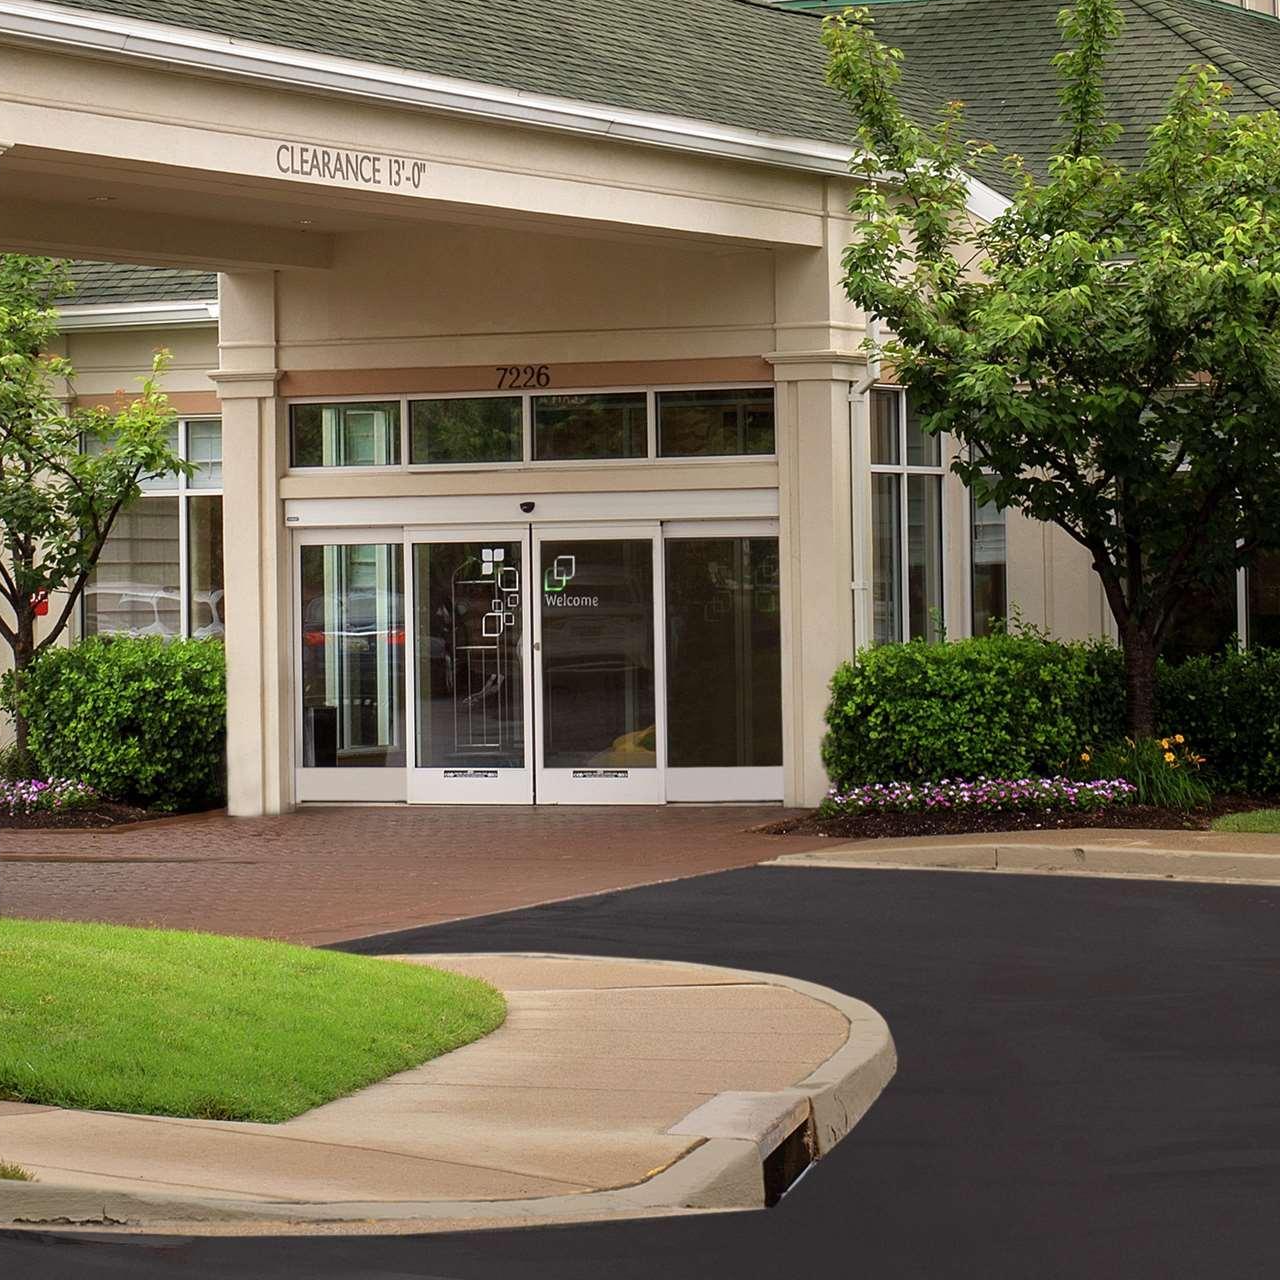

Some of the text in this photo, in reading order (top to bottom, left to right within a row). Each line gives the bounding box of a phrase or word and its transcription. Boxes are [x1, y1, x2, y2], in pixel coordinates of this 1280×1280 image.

[276, 144, 381, 184] CLEARANCE
[495, 364, 550, 389] 7226
[544, 593, 600, 608] Welcome
